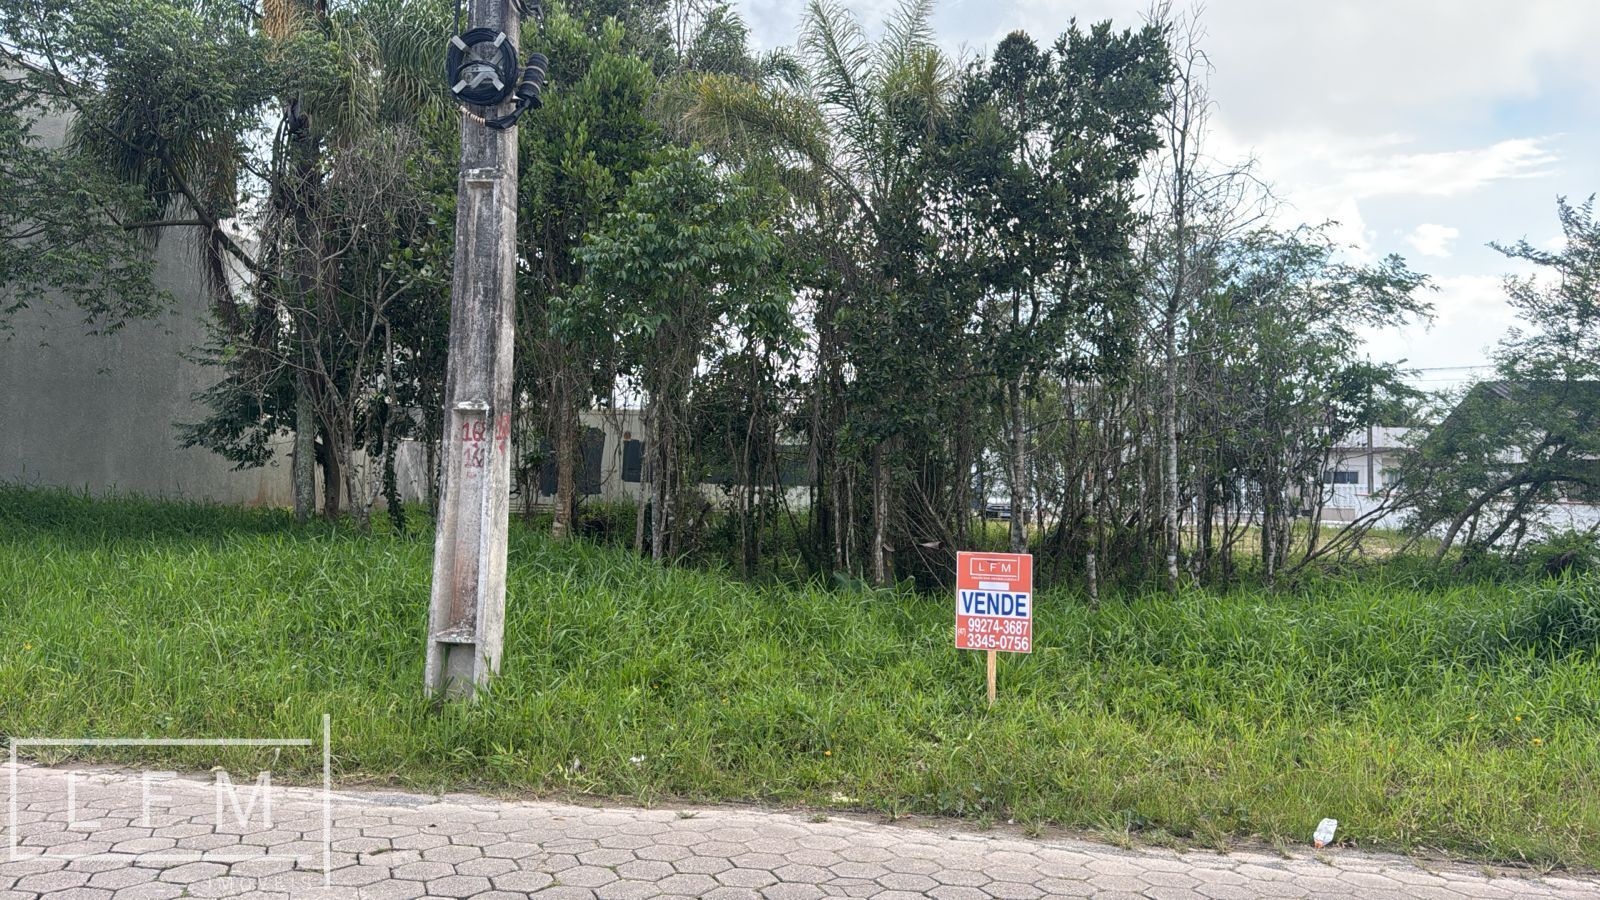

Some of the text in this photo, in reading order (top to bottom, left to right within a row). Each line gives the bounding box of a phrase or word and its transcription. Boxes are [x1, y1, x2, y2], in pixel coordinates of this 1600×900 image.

[962, 591, 1027, 617] VENDE
[967, 618, 1029, 635] 99274-3687
[967, 633, 1029, 650] 3345-0756
